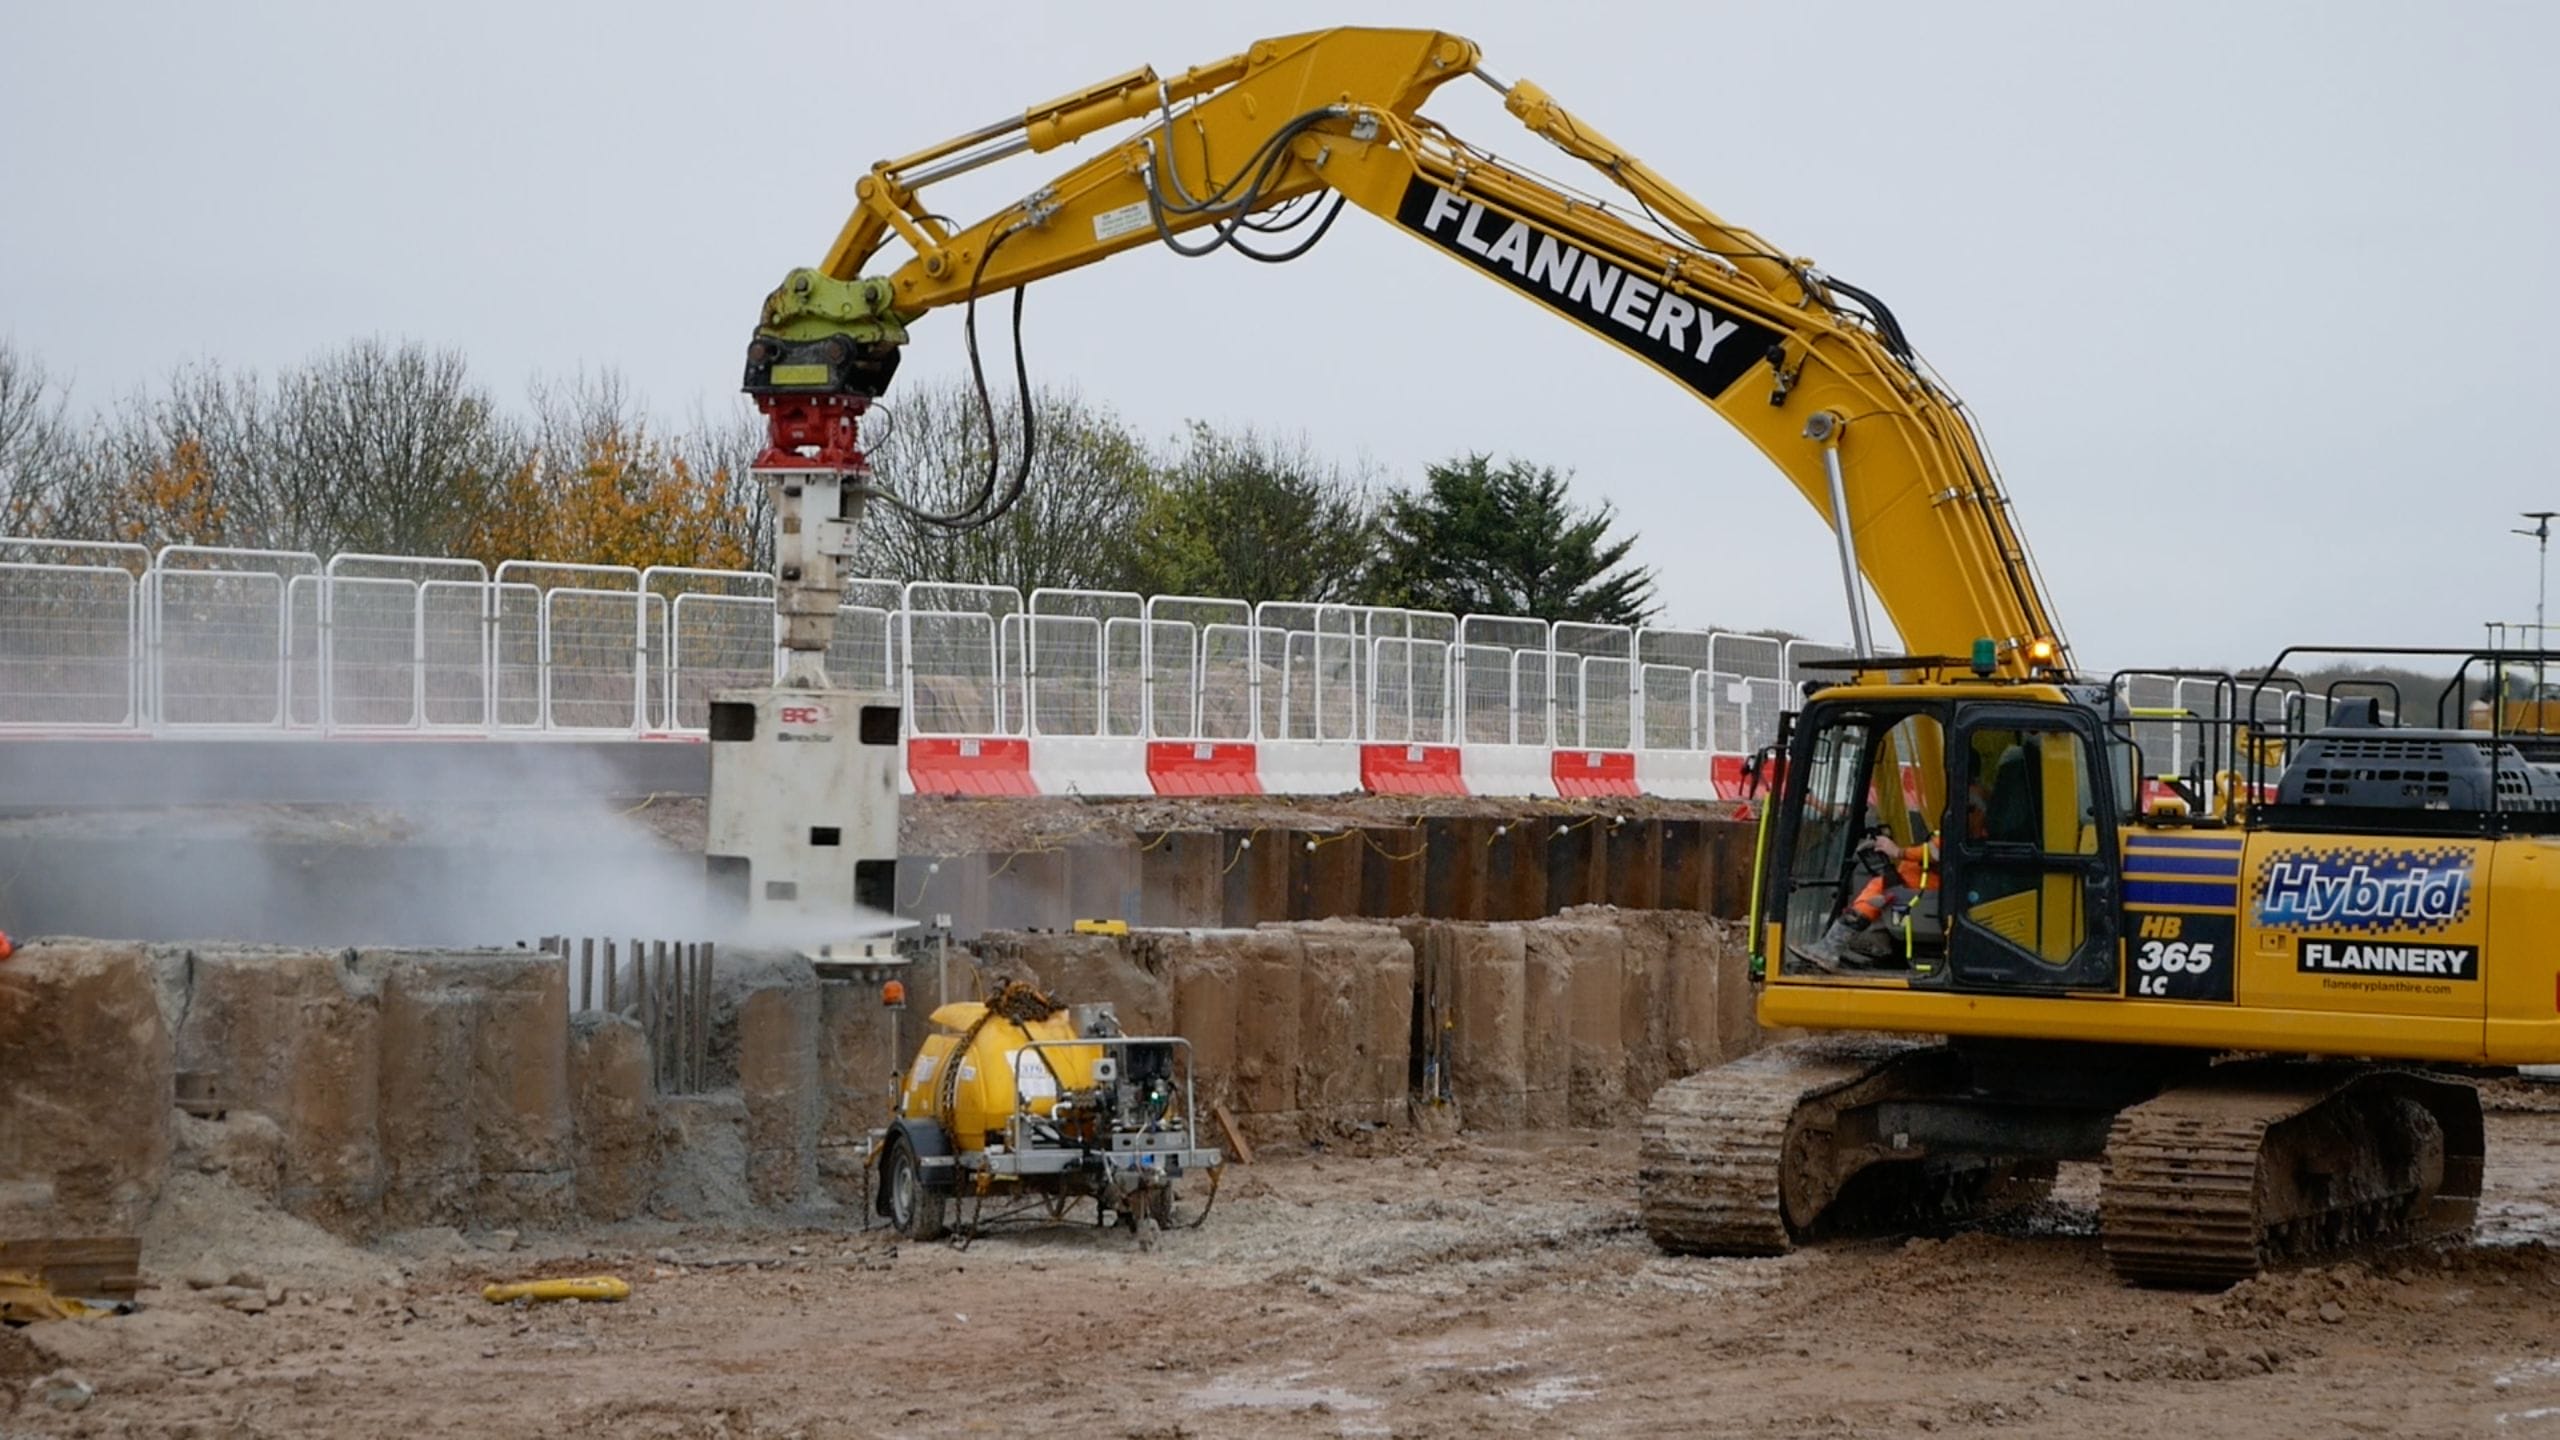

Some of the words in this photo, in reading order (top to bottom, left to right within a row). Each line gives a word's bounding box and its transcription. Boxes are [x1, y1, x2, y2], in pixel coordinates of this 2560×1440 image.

[1423, 186, 1739, 364] FLANNERY
[2264, 862, 2466, 921] Hybrid
[2139, 915, 2182, 939] HB
[2137, 940, 2214, 975] 365
[2305, 944, 2468, 974] FLANNERY
[2138, 975, 2169, 995] LC
[2323, 978, 2452, 995] flanneryplanthire.com
